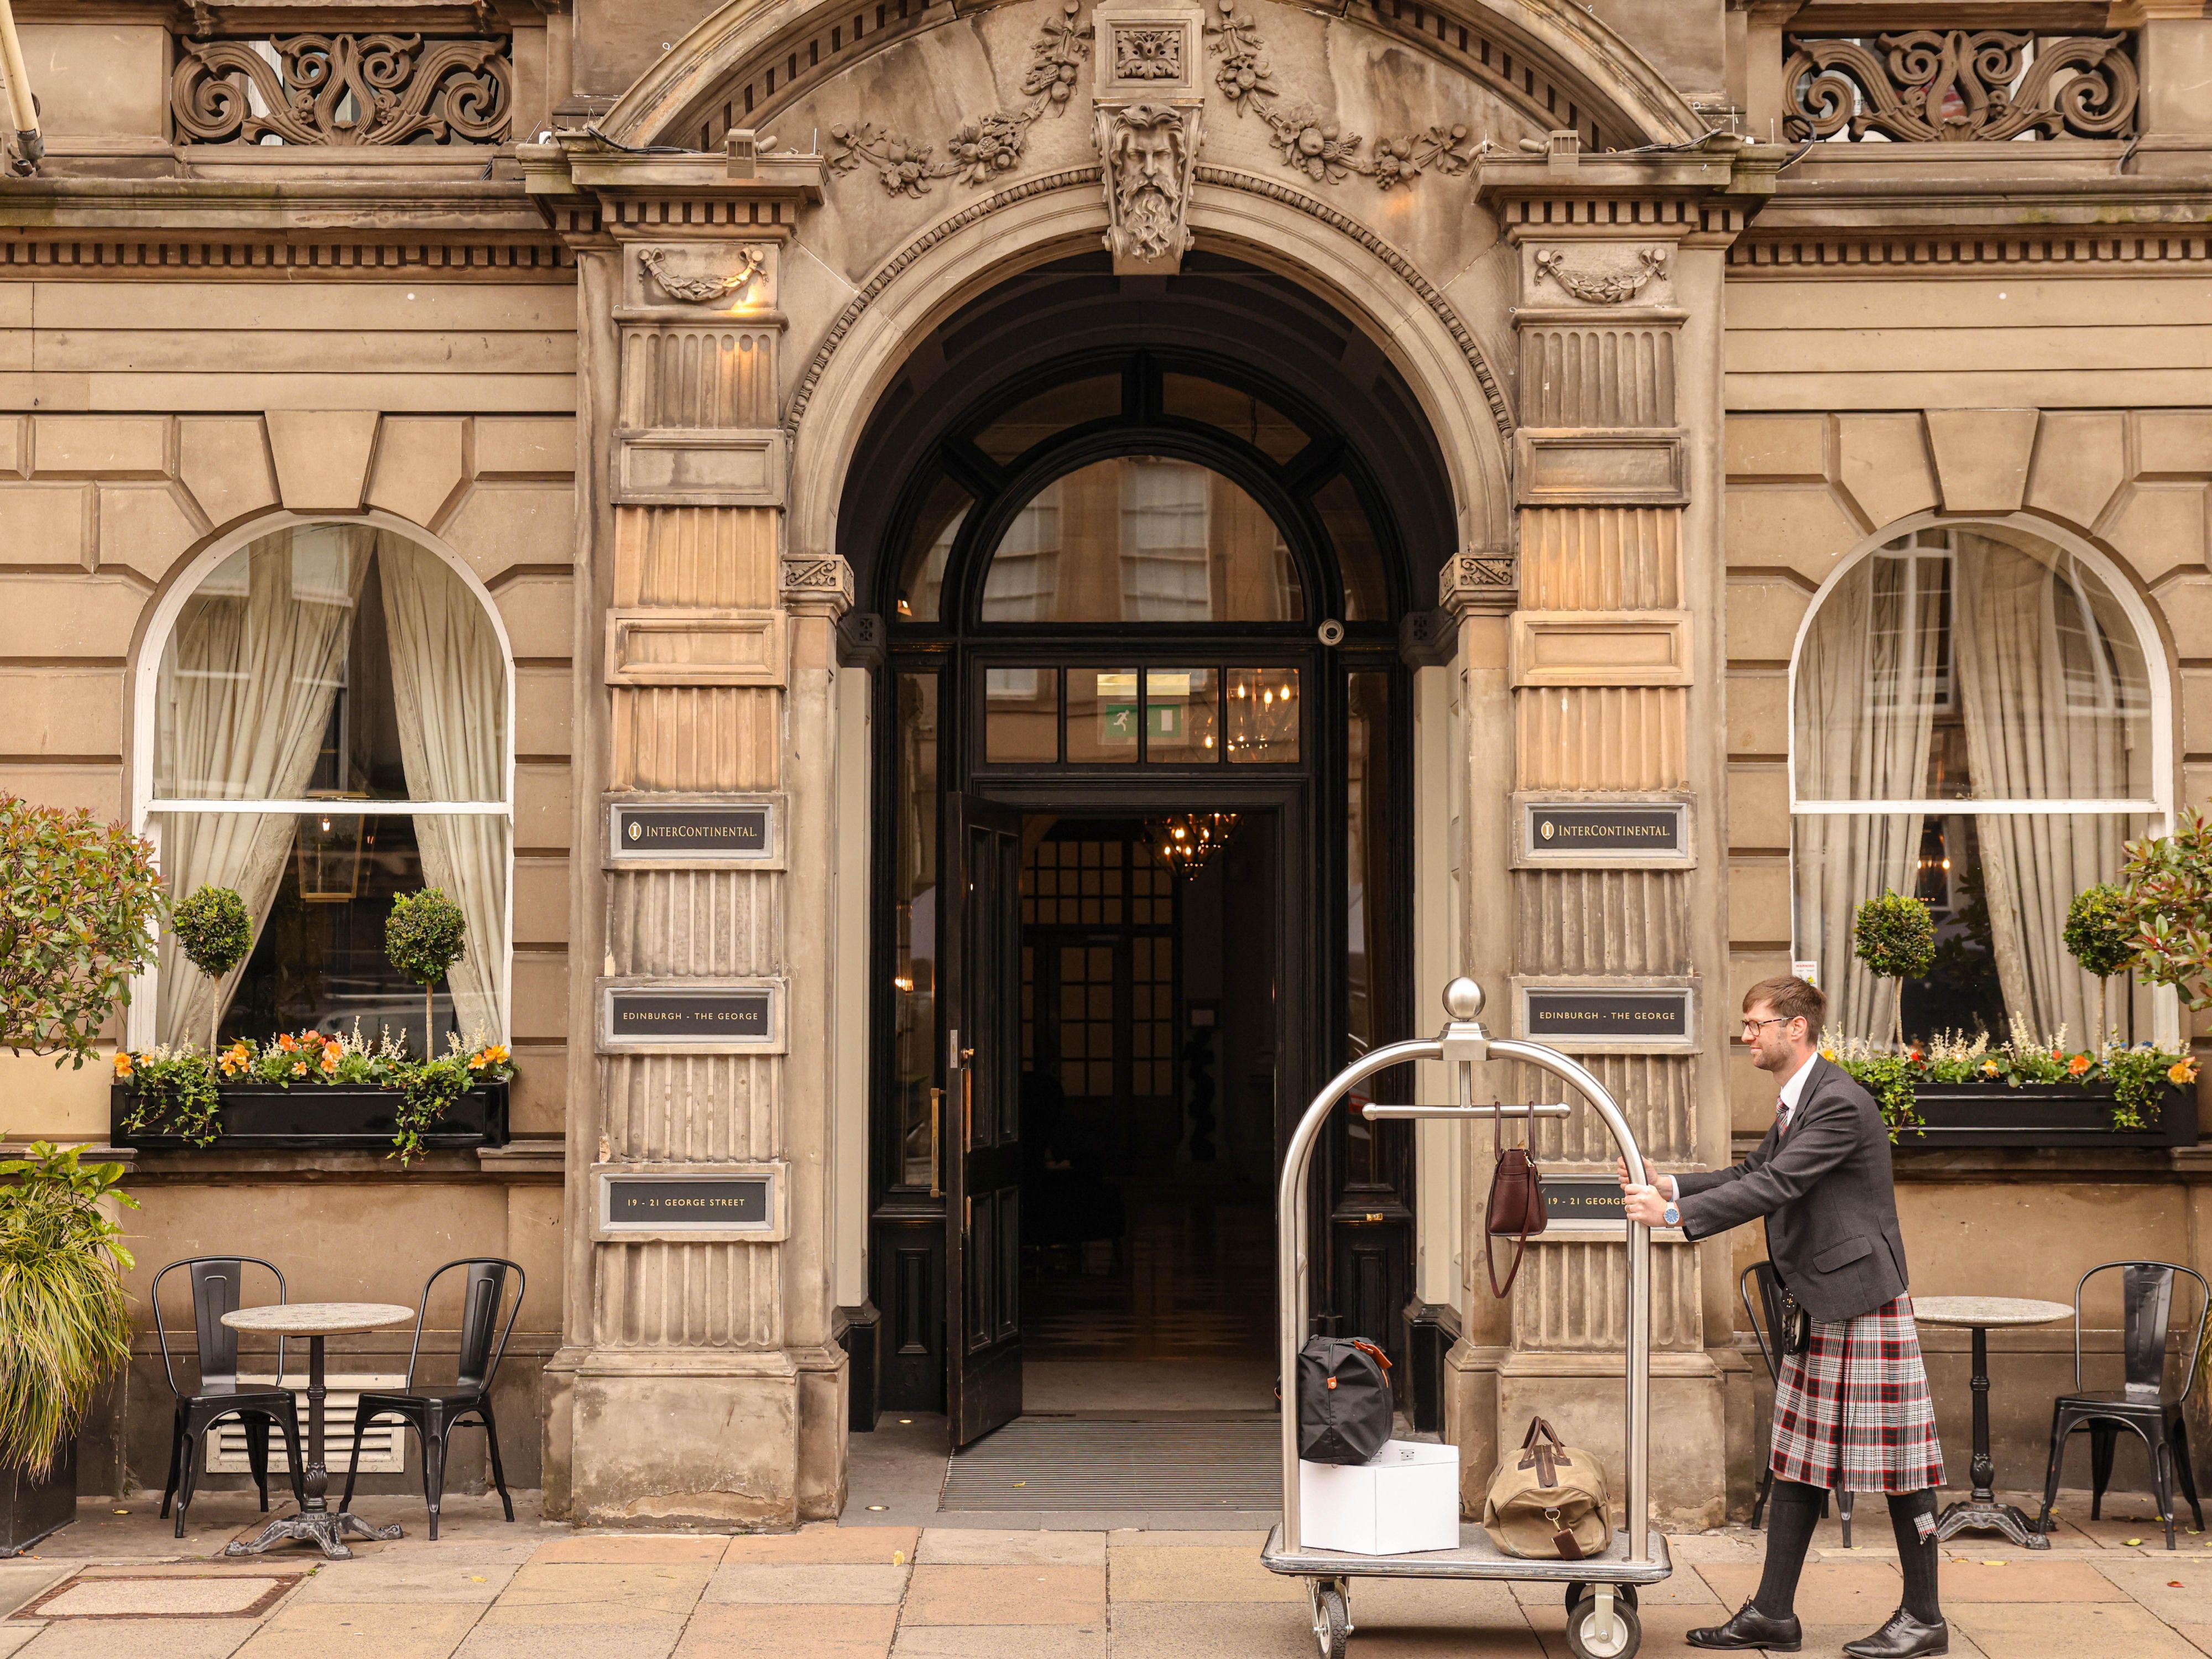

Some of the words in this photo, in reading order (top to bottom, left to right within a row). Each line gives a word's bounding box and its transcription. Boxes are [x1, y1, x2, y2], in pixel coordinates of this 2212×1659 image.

[650, 1198, 659, 1207] 21
[665, 1198, 705, 1207] GEORGE
[709, 1198, 745, 1207] STREET
[1399, 1449, 1415, 1461] JOHN
